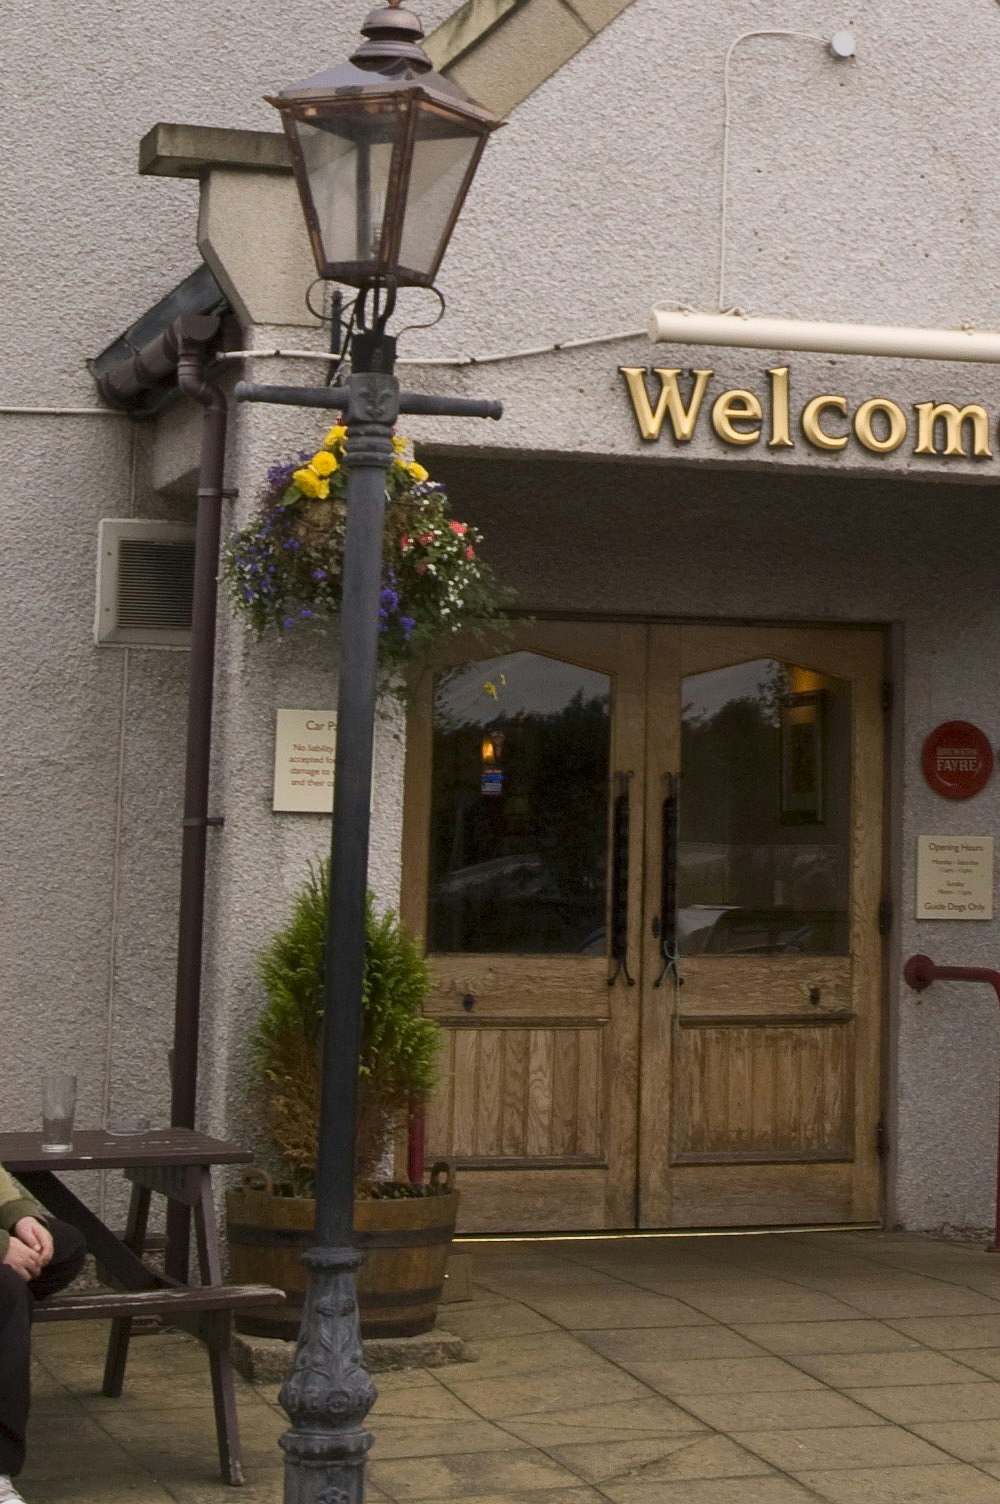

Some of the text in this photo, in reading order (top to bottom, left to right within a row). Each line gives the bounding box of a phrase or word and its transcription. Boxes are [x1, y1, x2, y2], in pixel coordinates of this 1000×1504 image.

[306, 720, 325, 730] Car
[936, 759, 977, 771] FAYRE
[928, 842, 984, 853] Opening Hours
[924, 902, 985, 912] Guide Dogs Only
